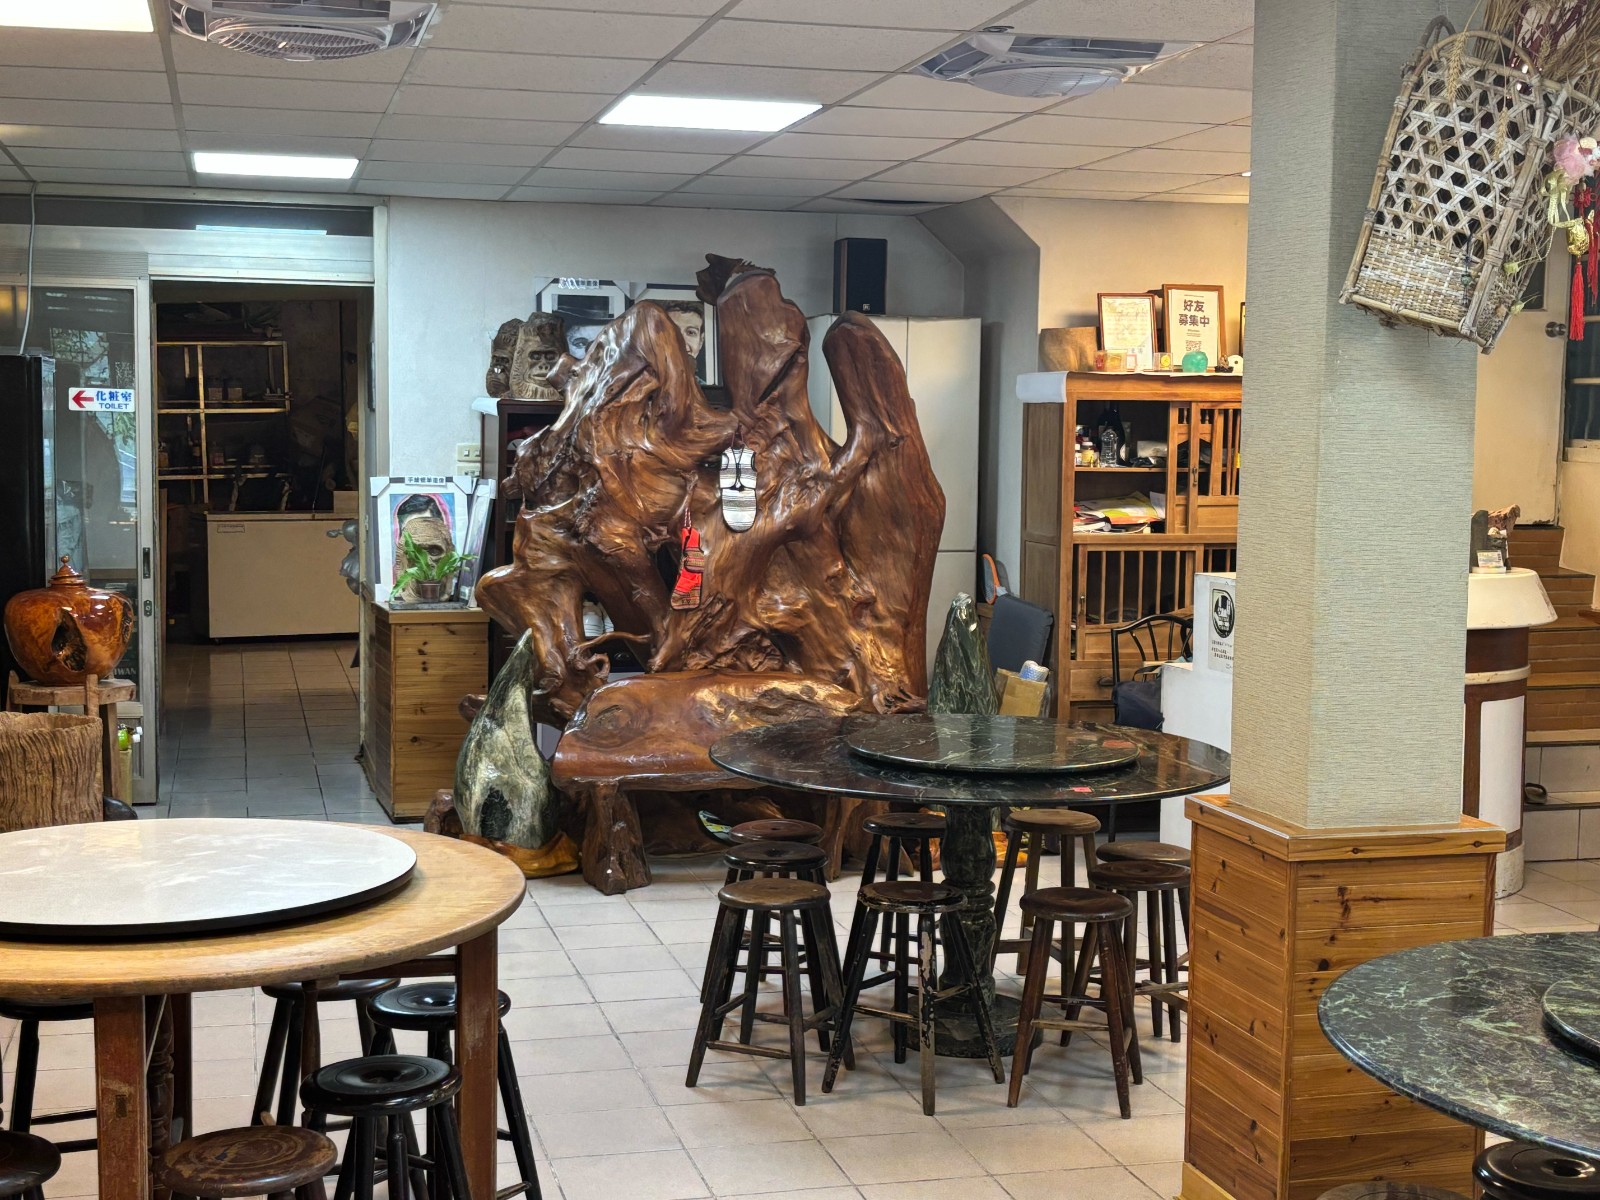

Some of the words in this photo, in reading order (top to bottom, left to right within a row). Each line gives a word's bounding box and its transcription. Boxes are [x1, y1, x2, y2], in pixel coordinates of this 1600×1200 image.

[1183, 299, 1205, 312] 好友
[1179, 313, 1209, 327] 募集中
[114, 667, 136, 676] IWAN
